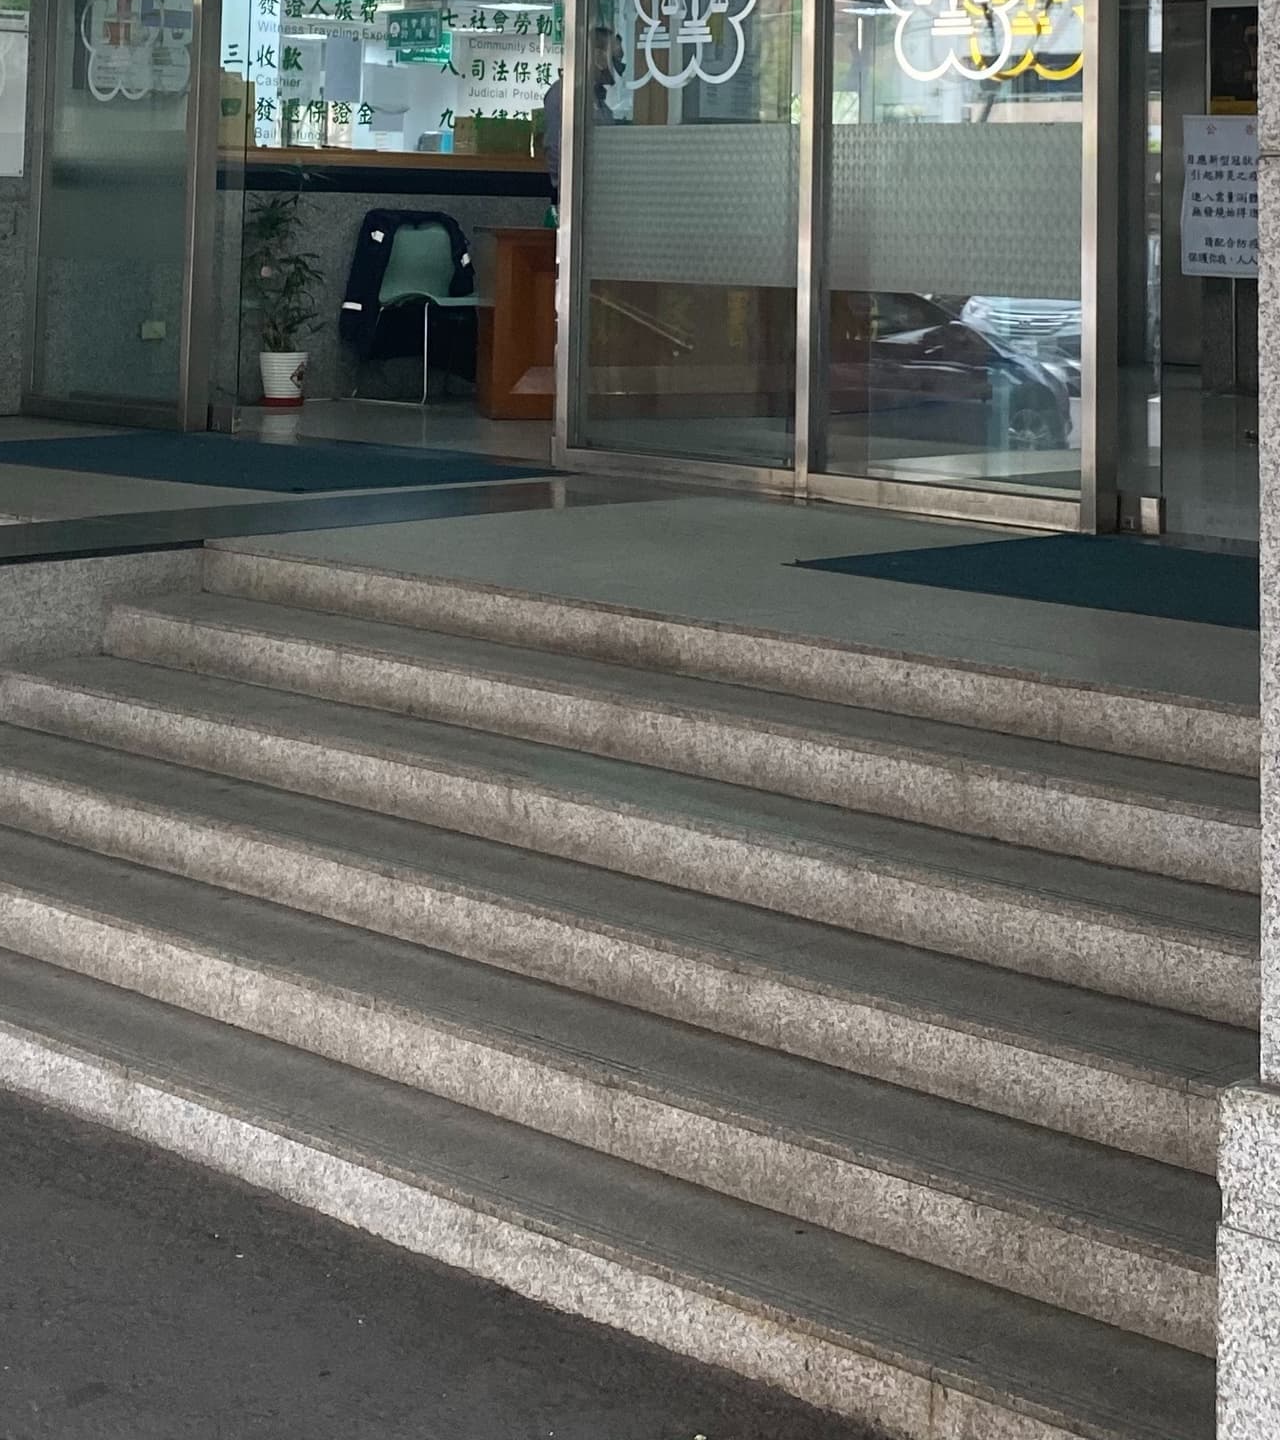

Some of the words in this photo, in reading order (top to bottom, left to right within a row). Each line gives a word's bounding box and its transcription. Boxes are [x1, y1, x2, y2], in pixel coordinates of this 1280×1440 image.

[257, 20, 305, 36] Witness
[307, 23, 360, 43] Traveling
[470, 38, 526, 55] Community
[255, 73, 303, 88] Cashier
[468, 87, 508, 100] Judicial
[254, 126, 277, 140] Bail
